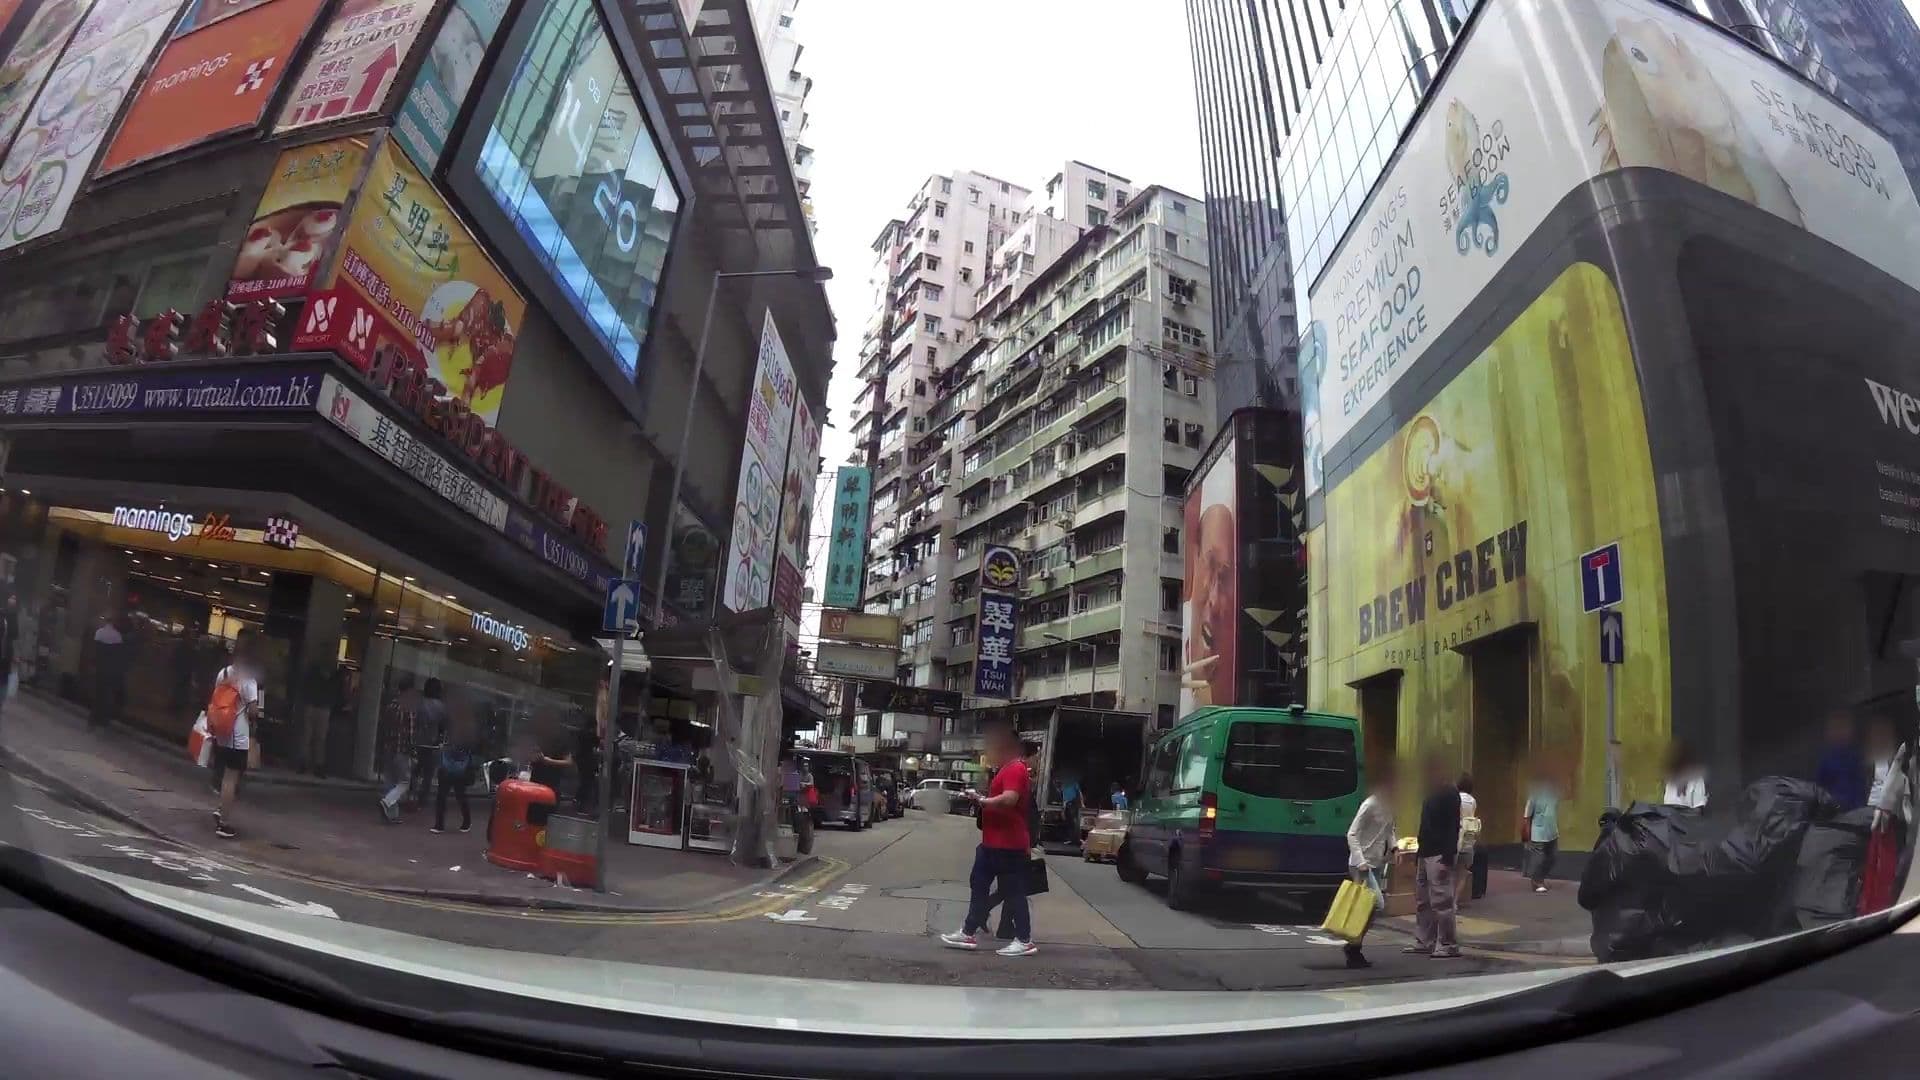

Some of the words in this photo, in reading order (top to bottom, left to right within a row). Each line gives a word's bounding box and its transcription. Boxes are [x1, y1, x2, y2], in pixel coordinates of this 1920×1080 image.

[152, 53, 232, 94] mannings
[1750, 79, 1876, 170] SEAFOOD
[1439, 119, 1504, 216] SEAFOOD
[1332, 253, 1362, 309] HONG
[1364, 186, 1407, 260] KONG'S
[1336, 218, 1415, 346] PREMIUM
[391, 302, 414, 334] 2110
[415, 321, 437, 353] 0101
[1340, 265, 1421, 382] SEAFOOD
[1344, 304, 1428, 416] EXPERIENCE
[143, 375, 315, 410] www.virtual.com.hk
[1864, 377, 1920, 435] We
[112, 505, 194, 542] mannings
[1359, 575, 1427, 646] BREW
[1436, 519, 1528, 611] CREW
[471, 611, 529, 652] mannings
[978, 601, 1015, 669] 翠華
[1384, 645, 1426, 664] PEOPLE
[1434, 609, 1492, 656] BARISTA
[980, 678, 1006, 692] WAH
[982, 668, 1007, 681] TSUI
